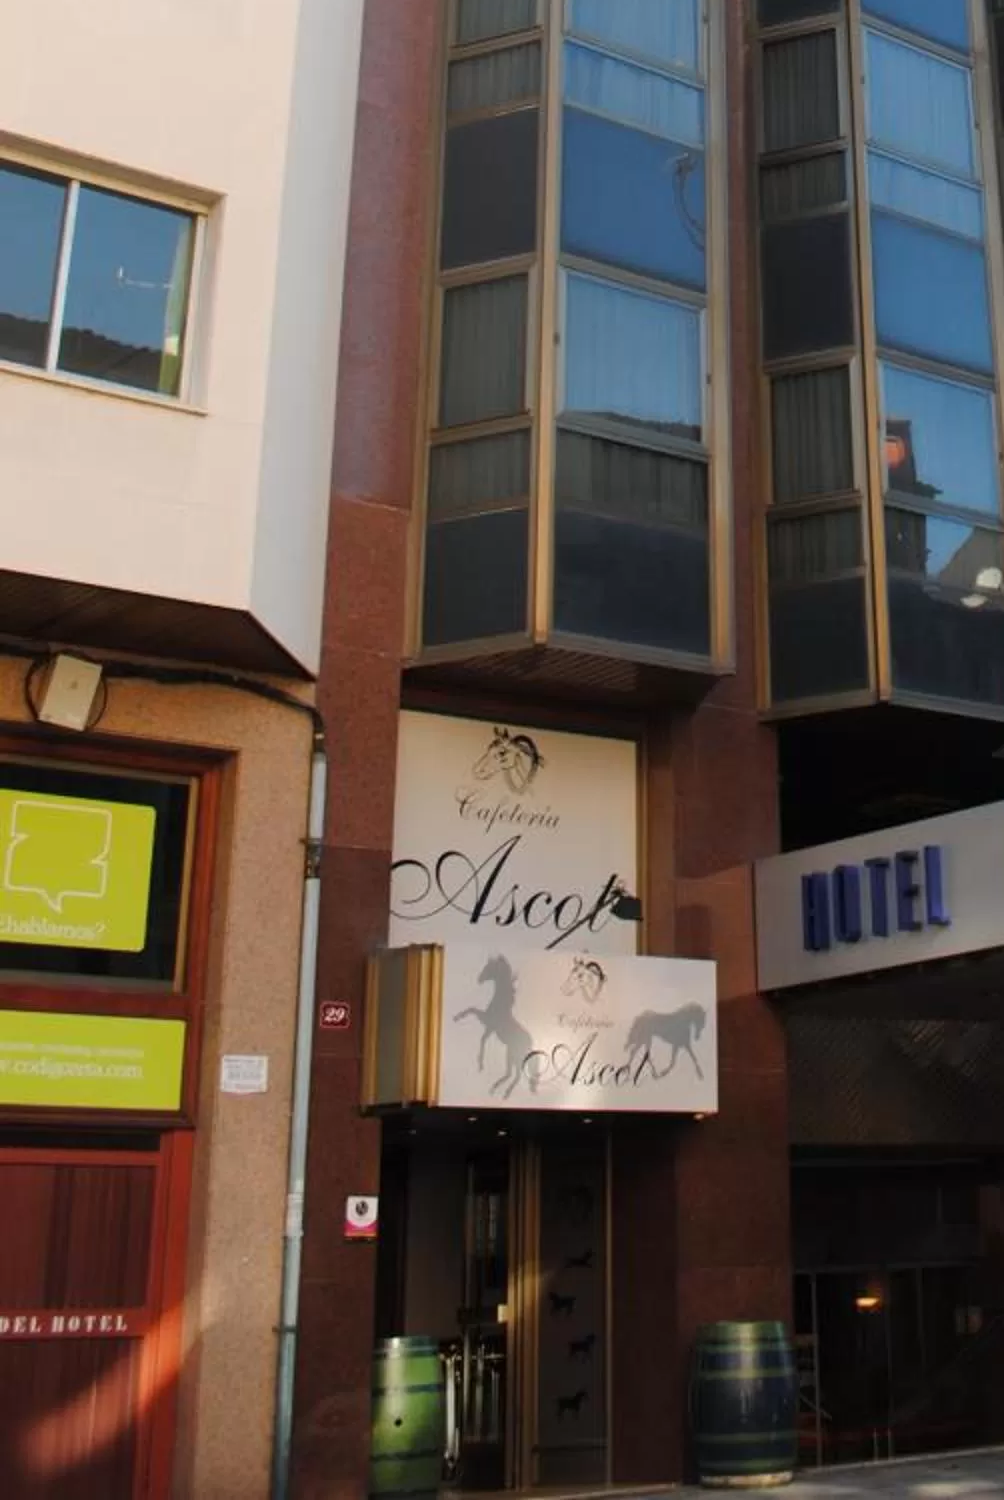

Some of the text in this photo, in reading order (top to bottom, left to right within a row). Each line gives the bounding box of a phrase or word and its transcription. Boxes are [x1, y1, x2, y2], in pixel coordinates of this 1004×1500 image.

[391, 835, 620, 950] Ascot
[801, 845, 951, 951] HOTEL
[324, 1007, 346, 1023] 29
[521, 1031, 650, 1088] Ascot
[0, 1315, 128, 1333] DEL HOTEL
